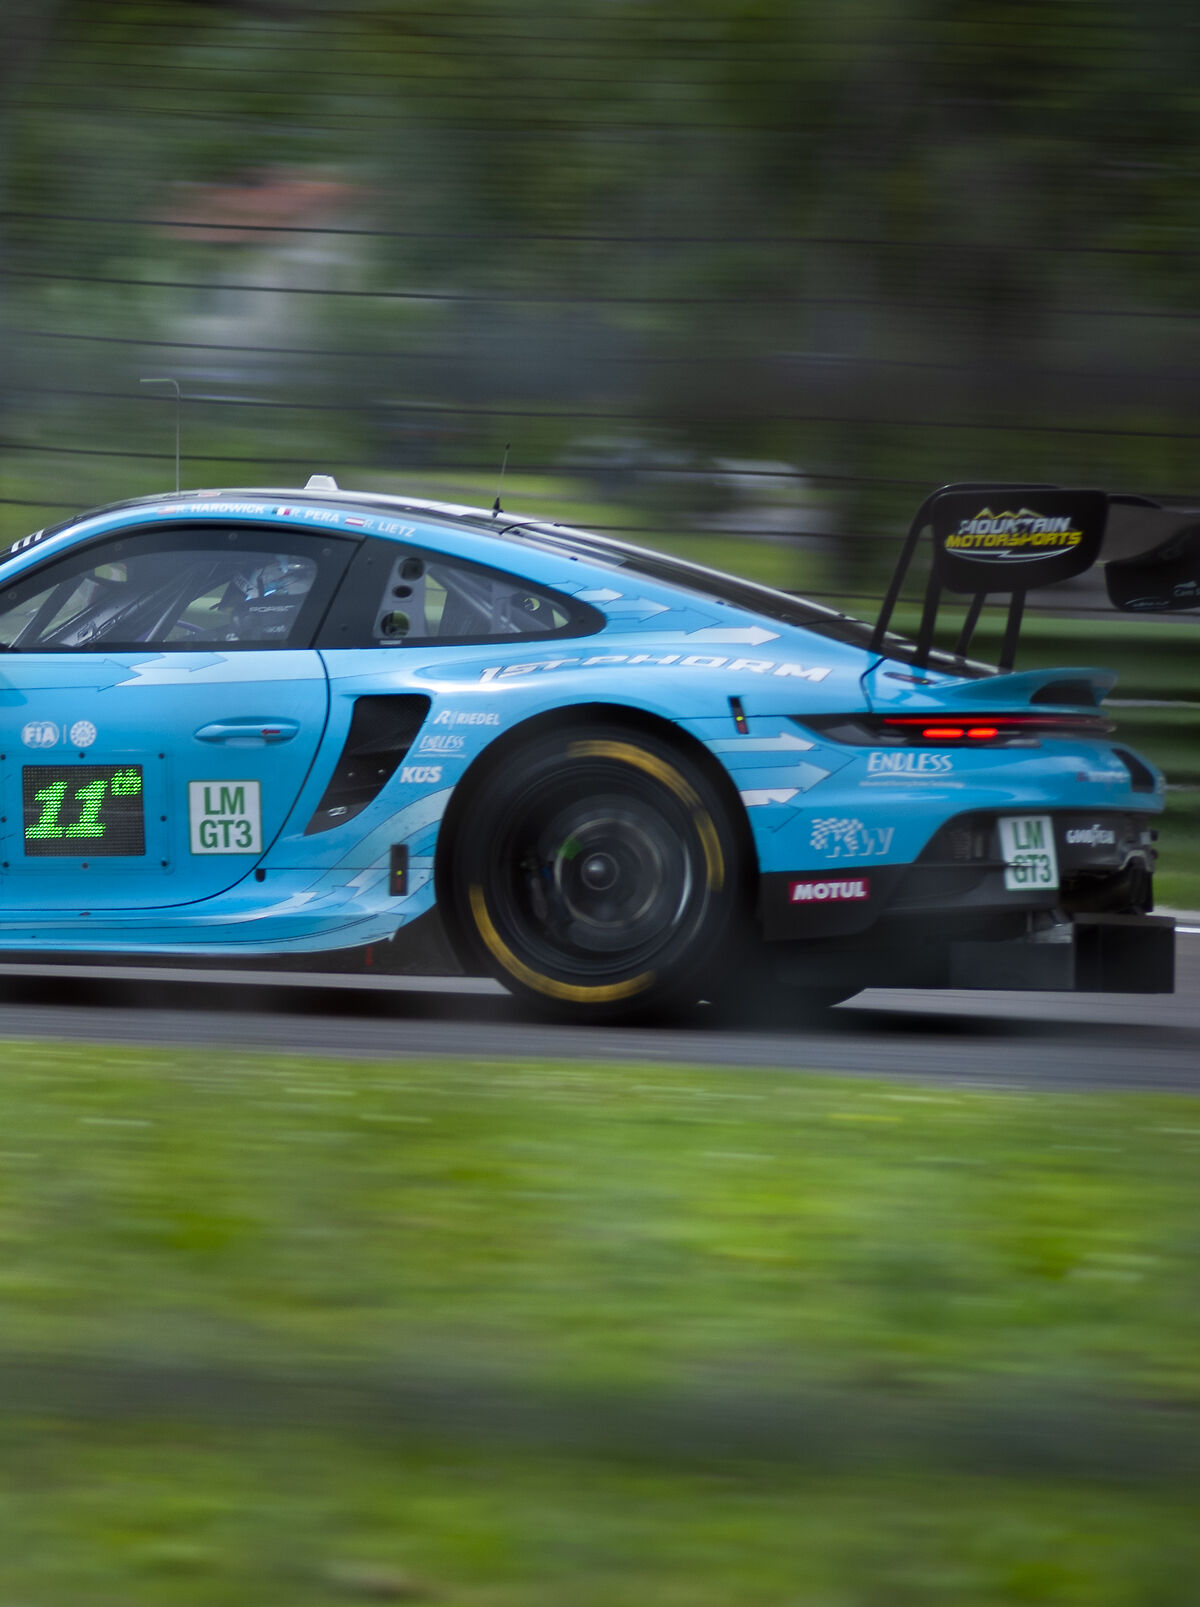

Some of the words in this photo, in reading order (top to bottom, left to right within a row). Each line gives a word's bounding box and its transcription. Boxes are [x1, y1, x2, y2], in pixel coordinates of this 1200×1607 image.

[191, 503, 264, 514] HARDWICK
[304, 509, 340, 523] PERA
[377, 521, 417, 538] LIETZ
[957, 517, 1072, 535] MOUNTAIN
[944, 531, 1083, 548] MOTORSPORTS
[456, 712, 501, 726] RIEDEL
[866, 751, 953, 772] ENDLESS
[204, 786, 246, 816] LM
[199, 819, 253, 849] GT3
[1011, 820, 1045, 850] LM
[1013, 854, 1052, 883] GT3
[793, 881, 867, 901] MOTUL
